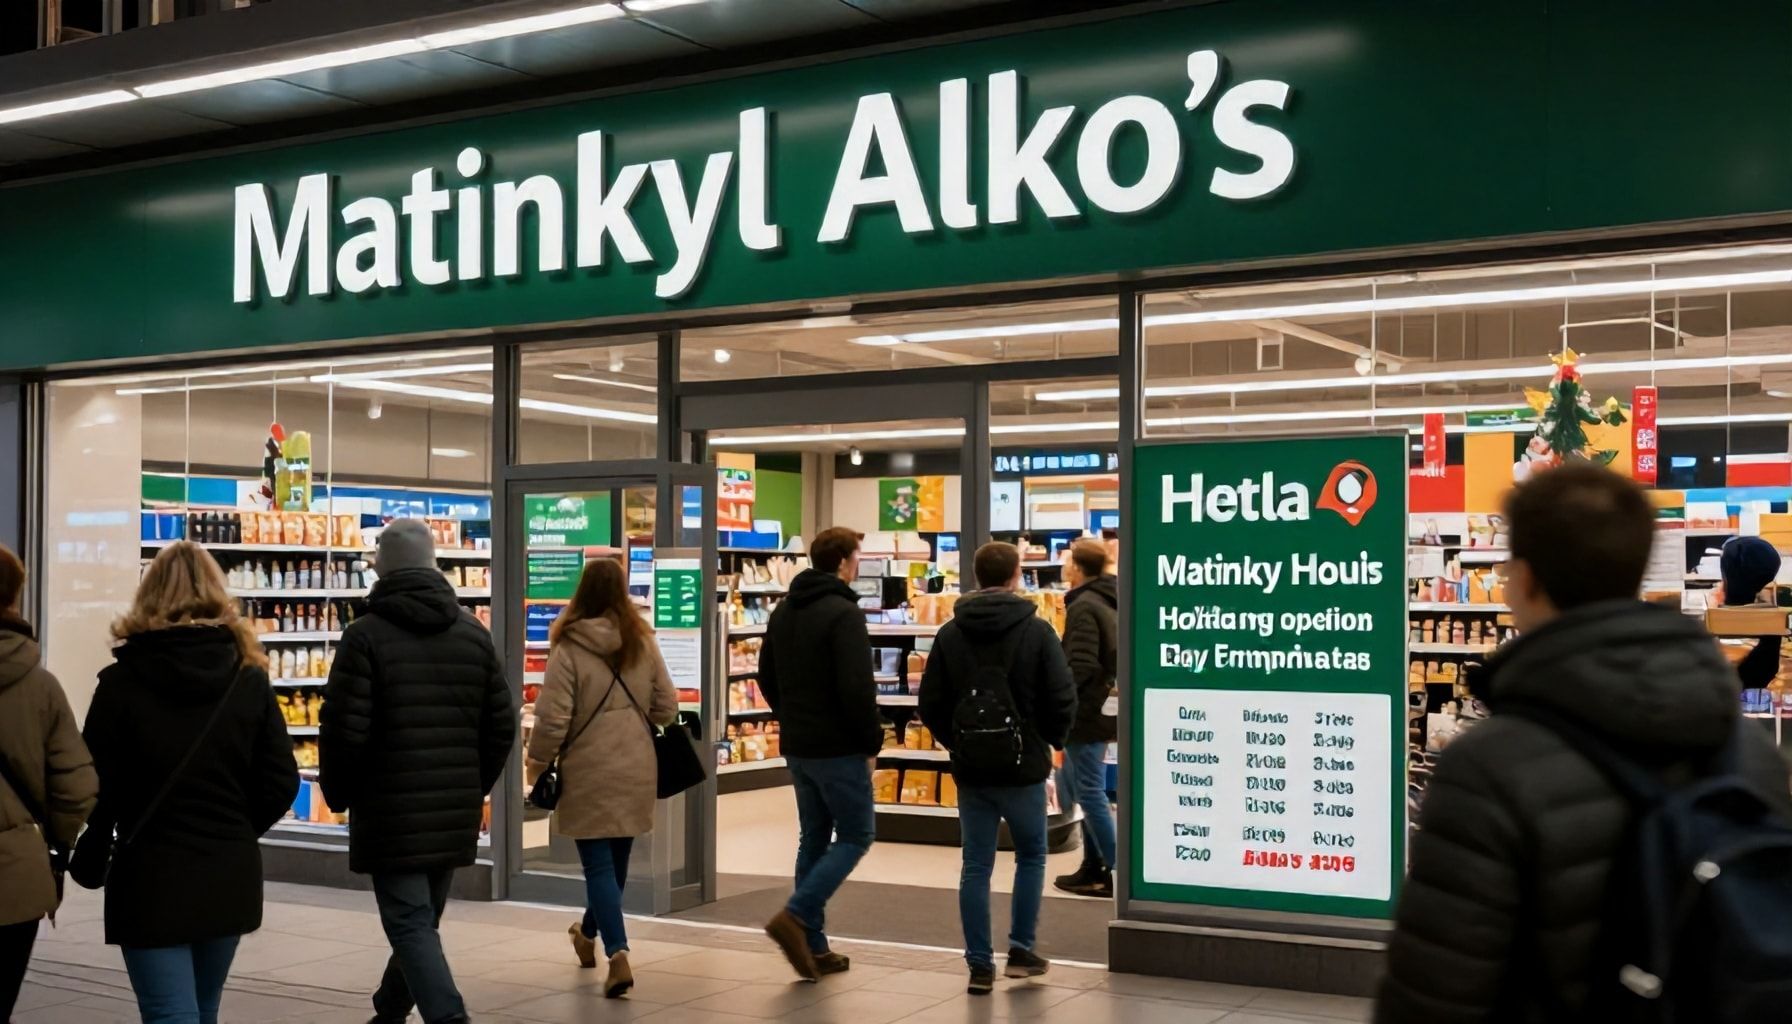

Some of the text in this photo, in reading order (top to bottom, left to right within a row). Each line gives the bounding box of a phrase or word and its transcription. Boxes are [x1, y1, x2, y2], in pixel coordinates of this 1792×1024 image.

[233, 49, 1296, 303] Matinkyl Alko's
[1161, 471, 1310, 523] Hetla
[1157, 552, 1283, 594] Matinky
